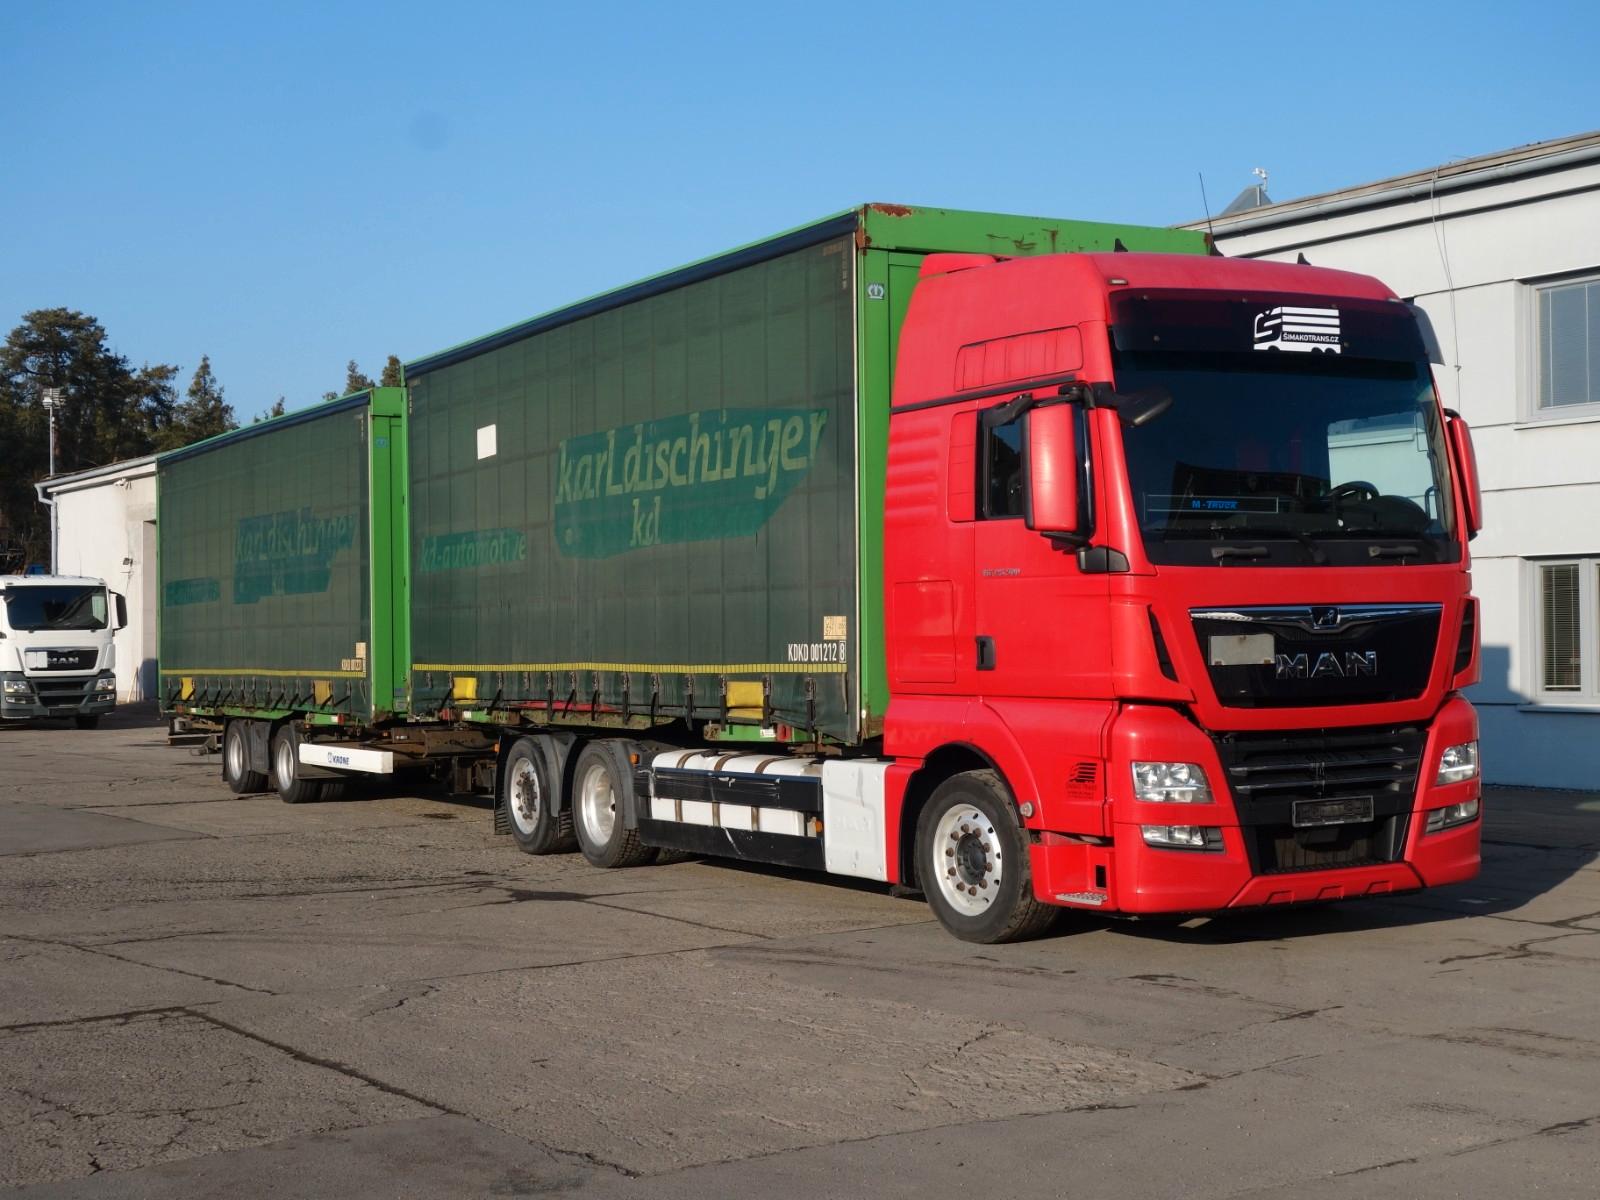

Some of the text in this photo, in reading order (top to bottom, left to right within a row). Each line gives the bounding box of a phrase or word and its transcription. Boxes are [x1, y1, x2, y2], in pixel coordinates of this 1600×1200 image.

[629, 495, 661, 547] kd
[788, 643, 809, 661] KDKD
[810, 643, 837, 661] 001212
[1276, 650, 1378, 679] MAN
[332, 755, 350, 765] KRONE
